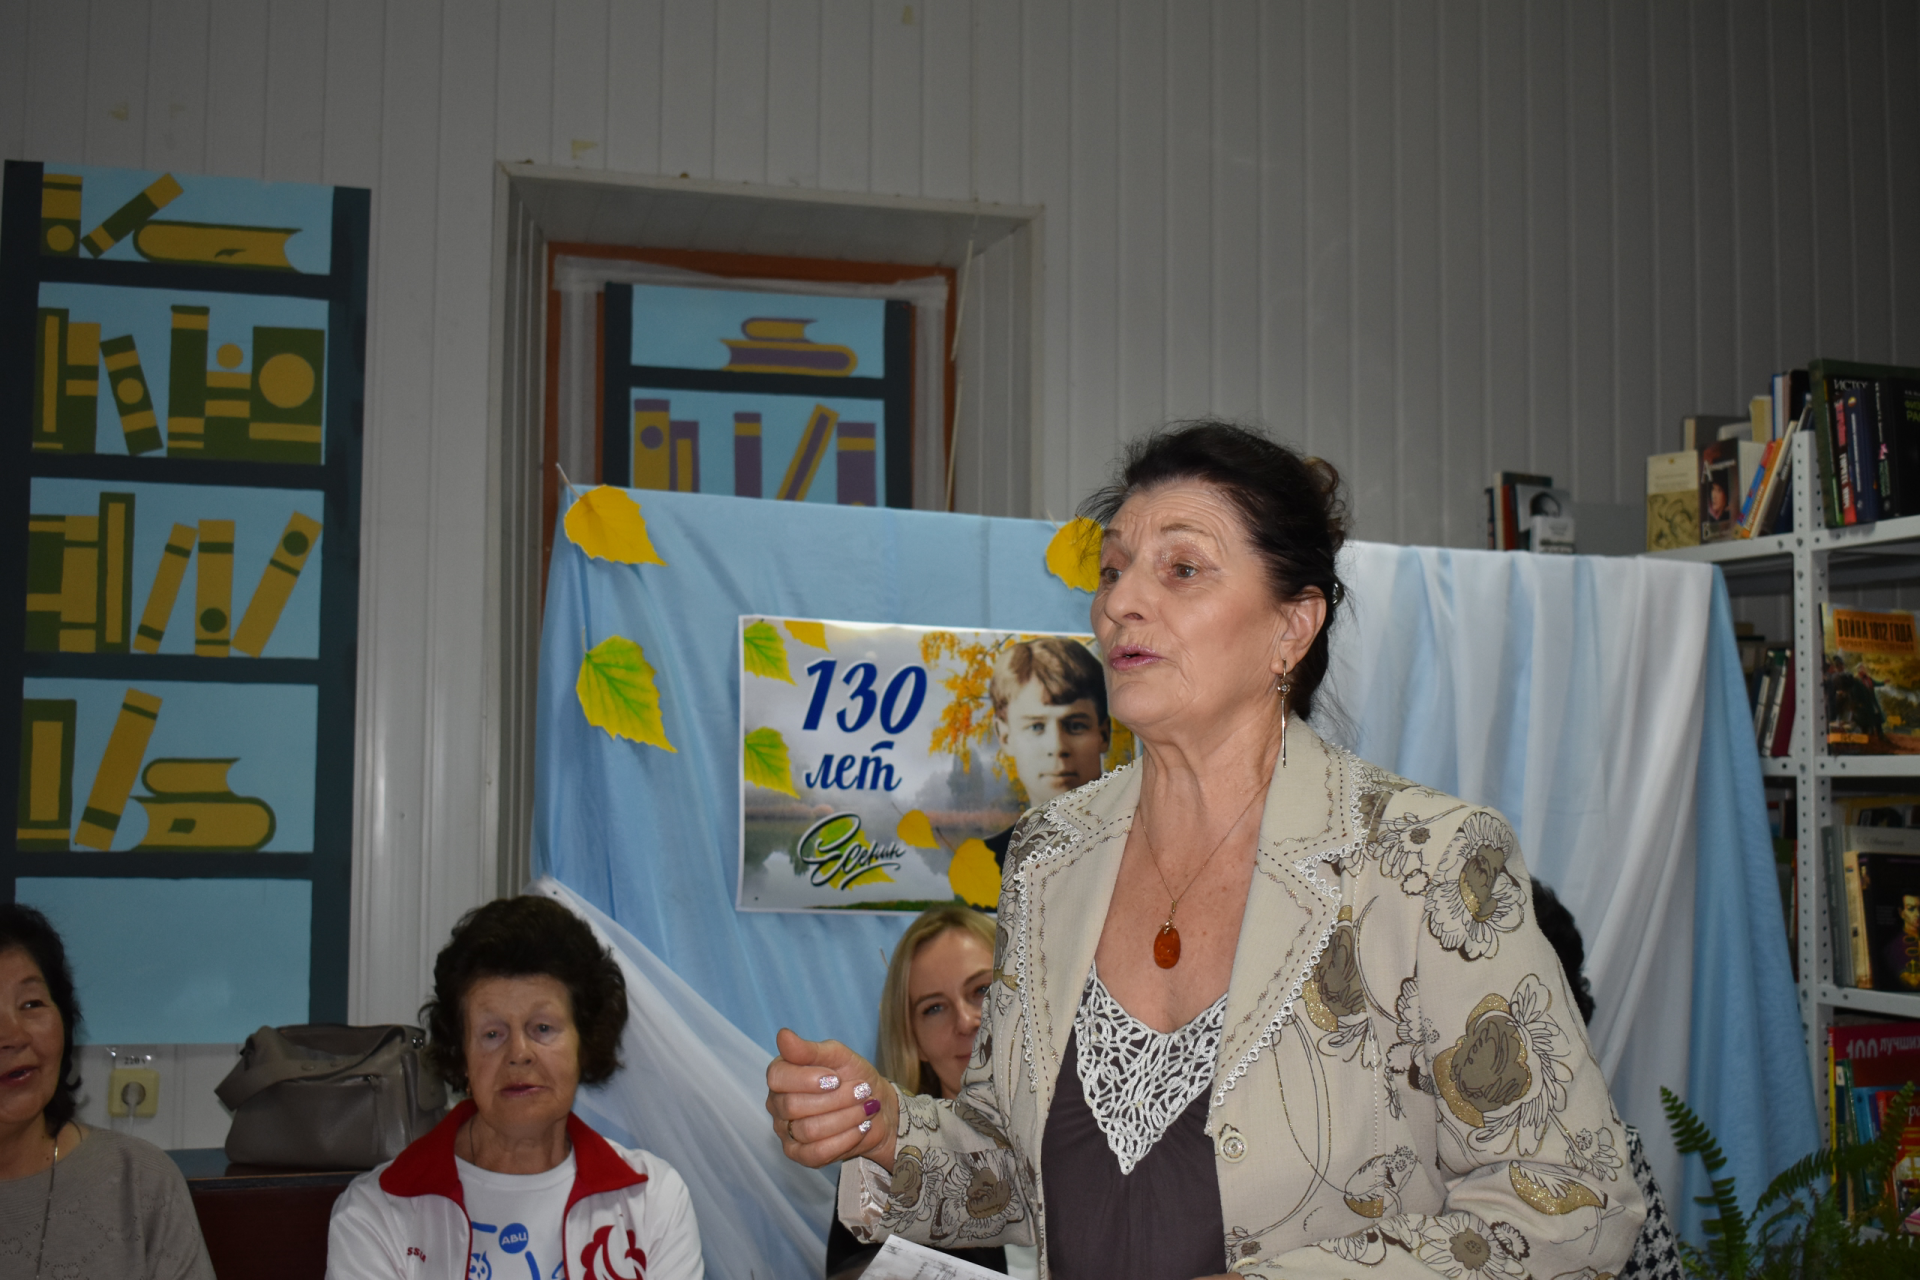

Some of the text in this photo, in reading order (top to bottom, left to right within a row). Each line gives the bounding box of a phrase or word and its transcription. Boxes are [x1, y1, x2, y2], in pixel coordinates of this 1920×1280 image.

[1838, 619, 1914, 643] ВОЙНА 1812 ГОДА
[802, 659, 927, 735] 130
[805, 740, 902, 792] лет
[797, 810, 905, 890] Есенин
[407, 1246, 426, 1263] SSIA
